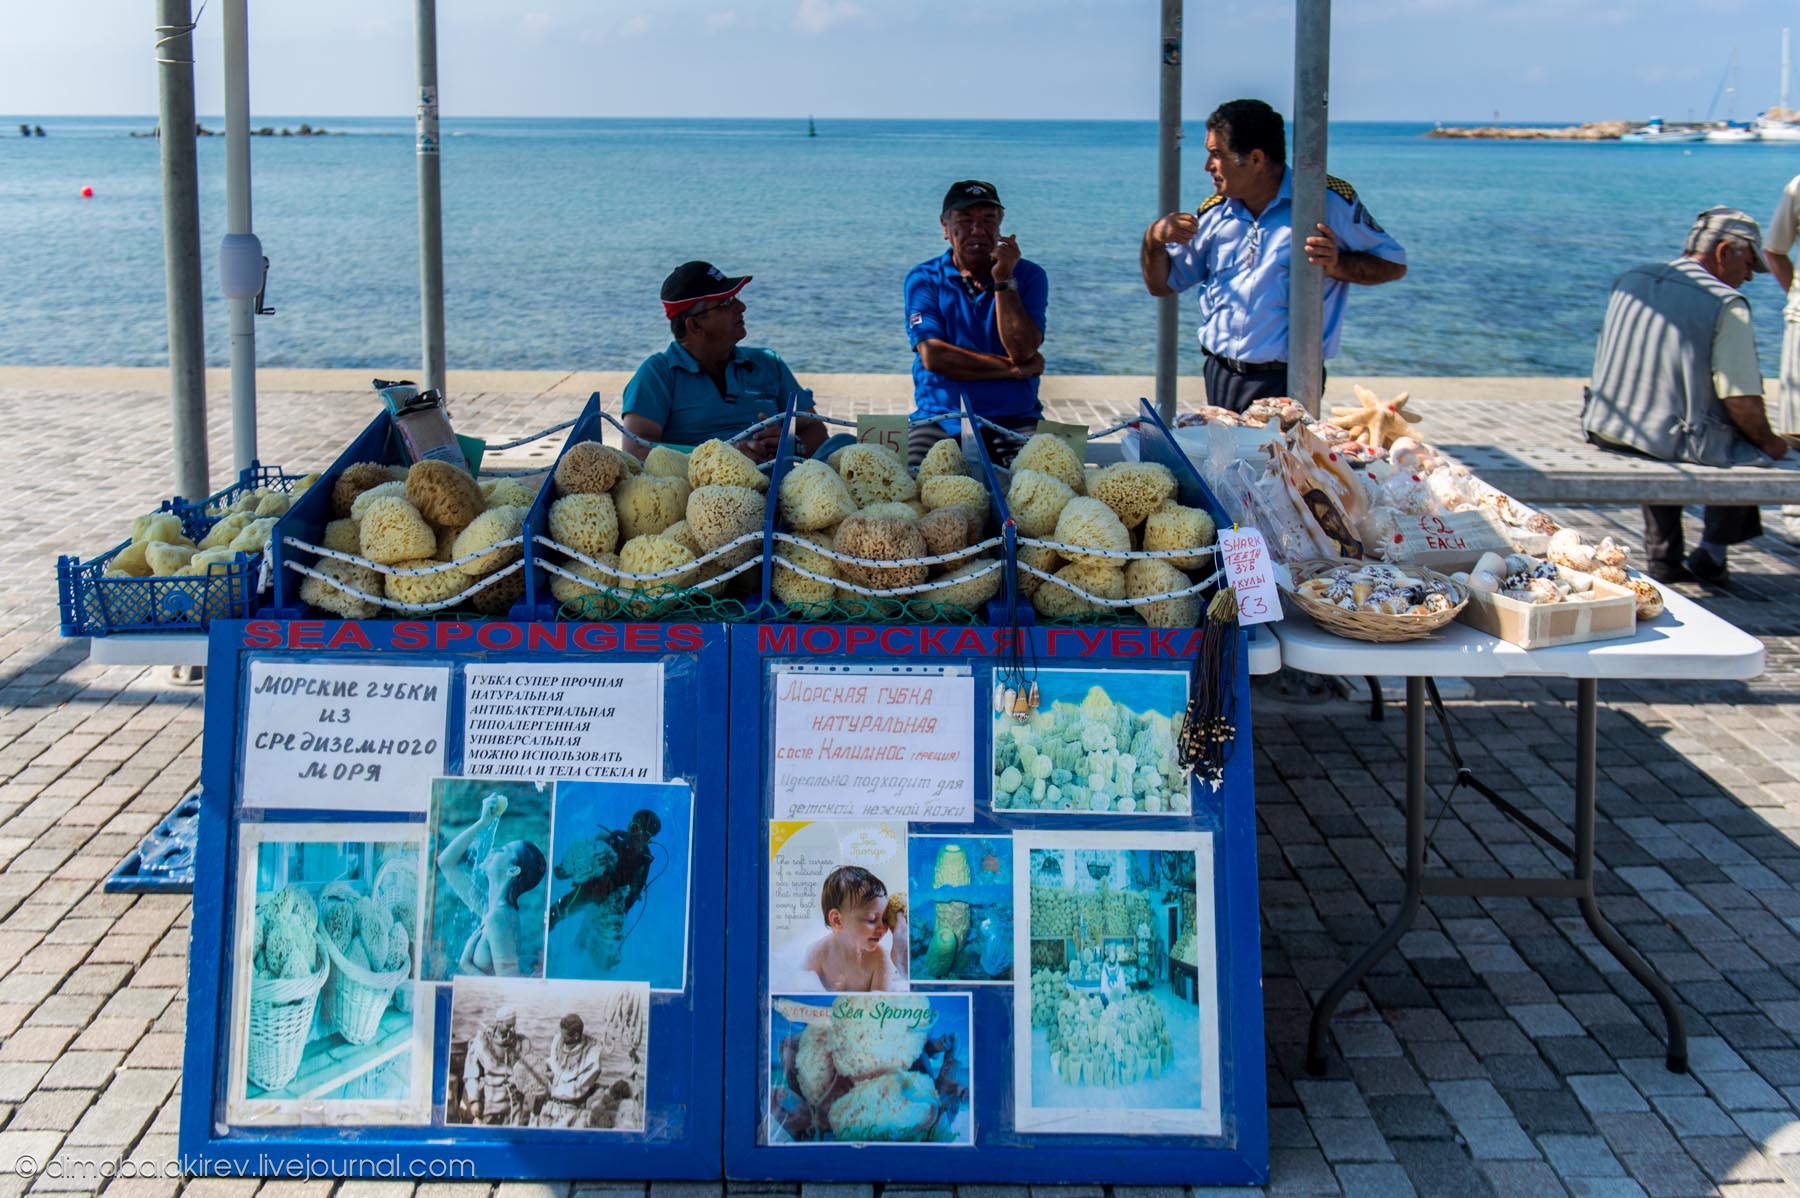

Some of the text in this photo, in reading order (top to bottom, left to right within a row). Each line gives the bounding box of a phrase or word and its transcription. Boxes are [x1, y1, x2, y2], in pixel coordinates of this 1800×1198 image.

[1419, 516, 1454, 534] €2
[1224, 536, 1260, 552] SHARK
[1426, 536, 1466, 549] EACH
[1225, 548, 1260, 565] TEETH
[1240, 596, 1268, 618] €3
[242, 622, 704, 651] SEA SPONGES
[758, 626, 1024, 655] МОРСКАЯ
[471, 675, 624, 688] ГУБКА СУПЕР ПРОЧНАЯ
[470, 690, 564, 702] НАТУРАЛЬНАЯ
[470, 704, 616, 718] АНТИБАКТЕРИАЛЬНАЯ
[469, 720, 592, 732] ГИПОАЛЕРГЕННАЯ
[469, 734, 582, 746] УНИВЕРСАЛЬНАЯ
[468, 749, 623, 762] МОЖНО ИСПОЛЬЗОВАТЬ
[467, 764, 648, 778] ДЛЯ ЛИЦА И ТЕЛА СТЕКЛА И
[932, 778, 964, 797] для
[832, 1002, 864, 1020] Sea
